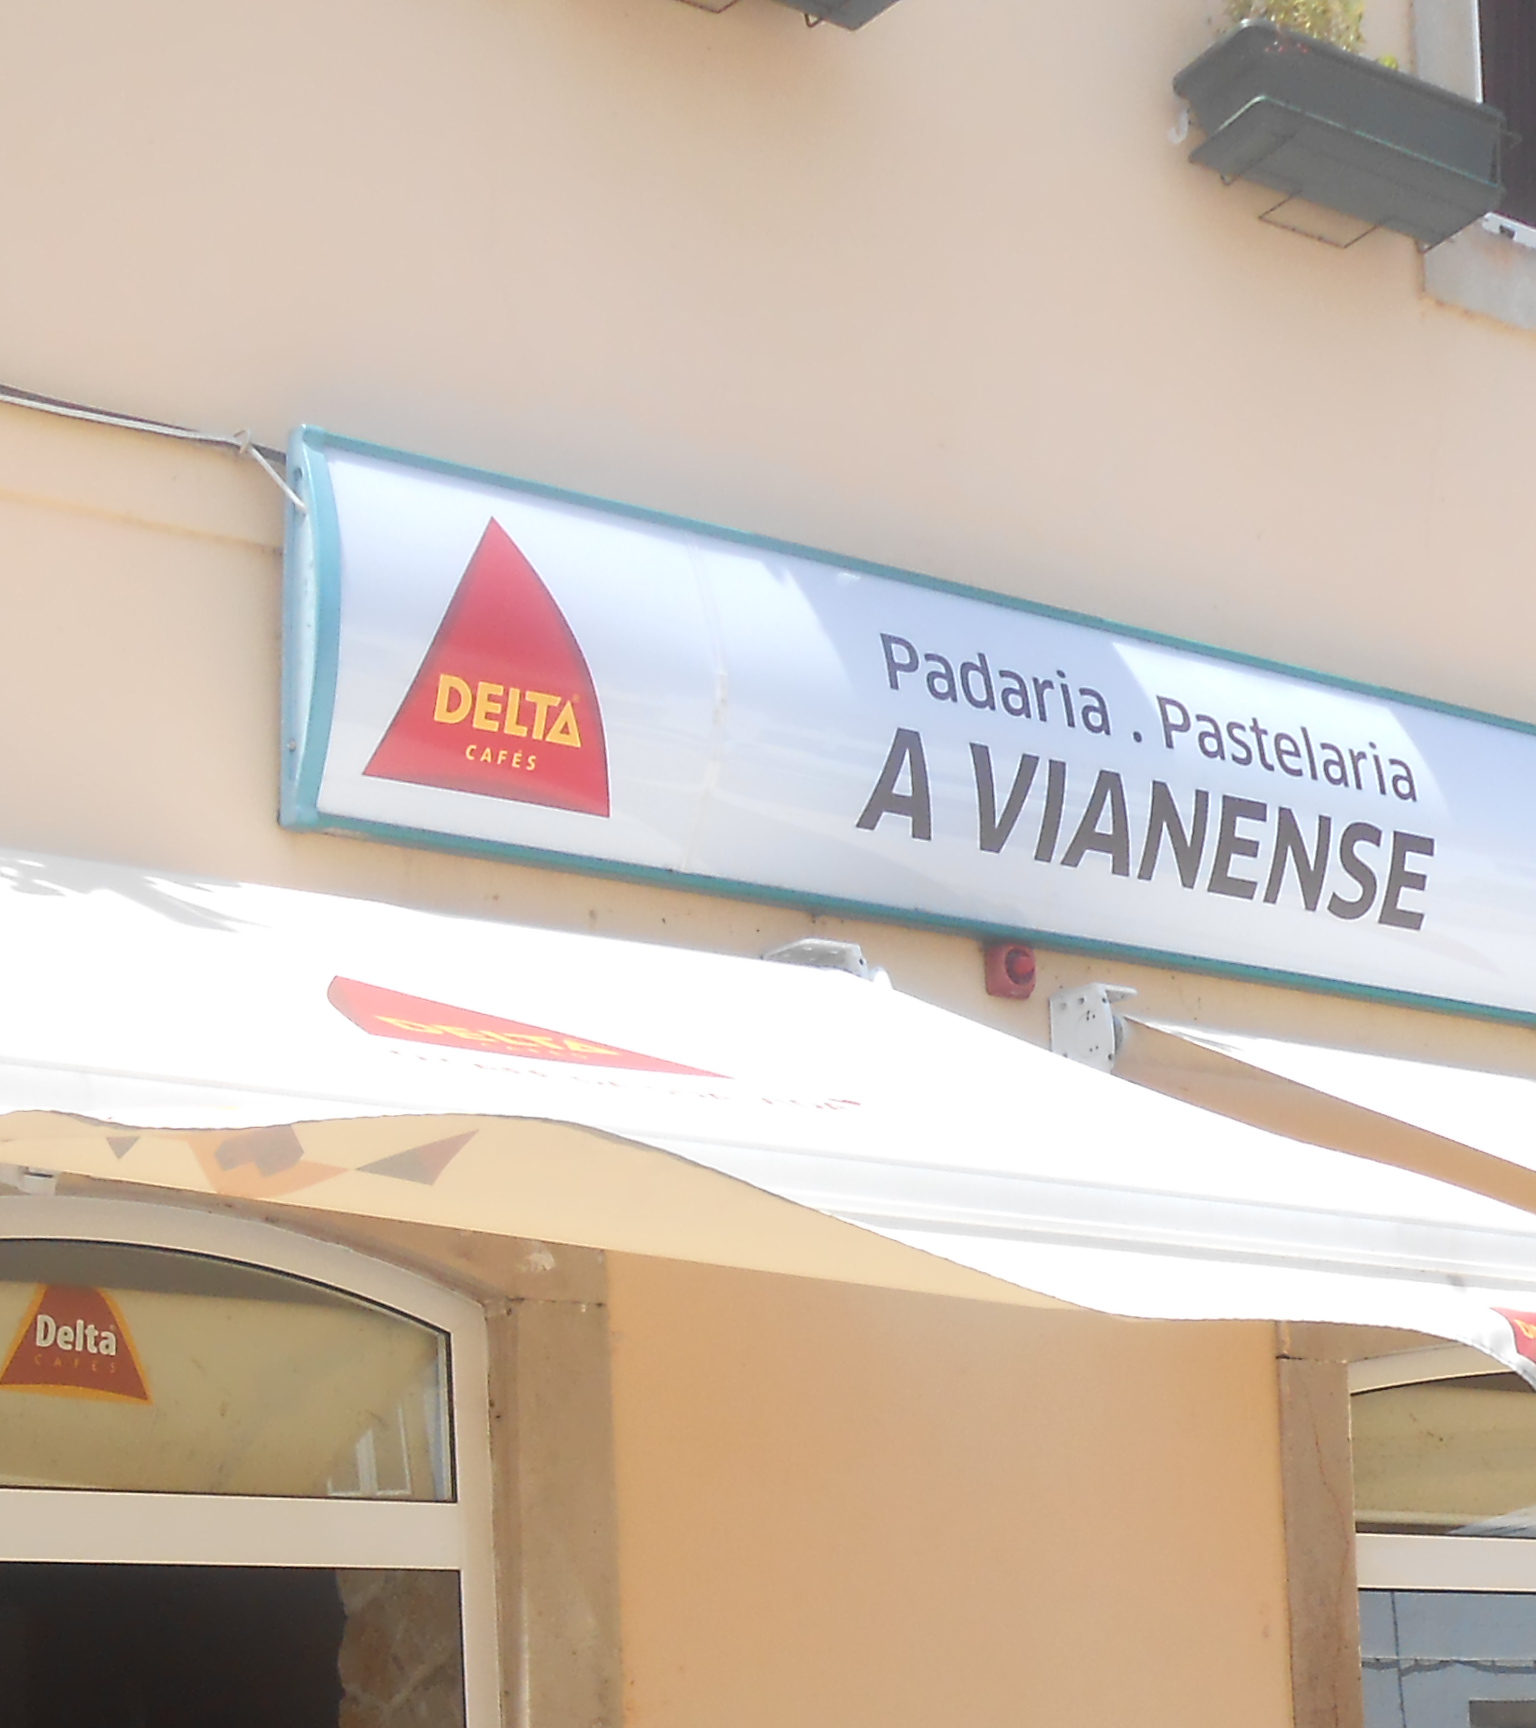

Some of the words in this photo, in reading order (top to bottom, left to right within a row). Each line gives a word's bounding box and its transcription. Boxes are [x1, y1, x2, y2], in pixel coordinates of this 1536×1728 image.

[433, 673, 582, 749] DELTA
[879, 632, 1112, 736] Padaria
[1155, 694, 1419, 803] Pastelaria
[465, 743, 537, 771] CAFÉS
[855, 727, 933, 841] A
[968, 741, 1436, 931] VIANENSE
[36, 1314, 117, 1356] Delta
